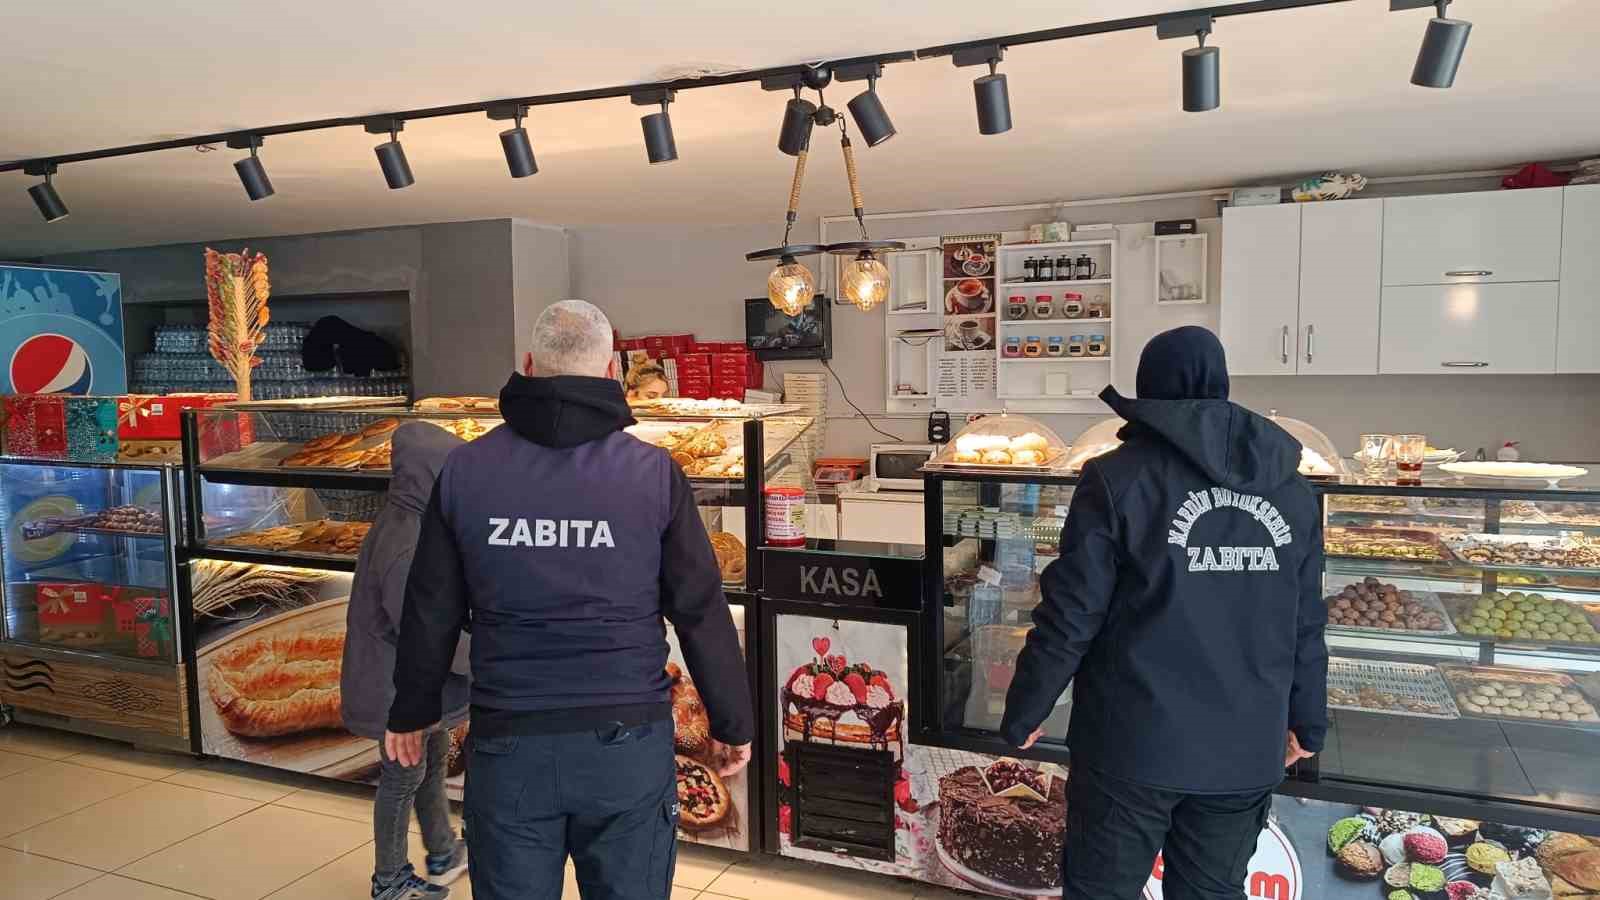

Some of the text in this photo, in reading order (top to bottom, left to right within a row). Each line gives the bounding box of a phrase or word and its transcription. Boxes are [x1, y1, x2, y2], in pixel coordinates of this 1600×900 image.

[488, 517, 615, 548] ZABITA
[1187, 546, 1279, 572] ZABITA
[800, 566, 883, 598] KASA
